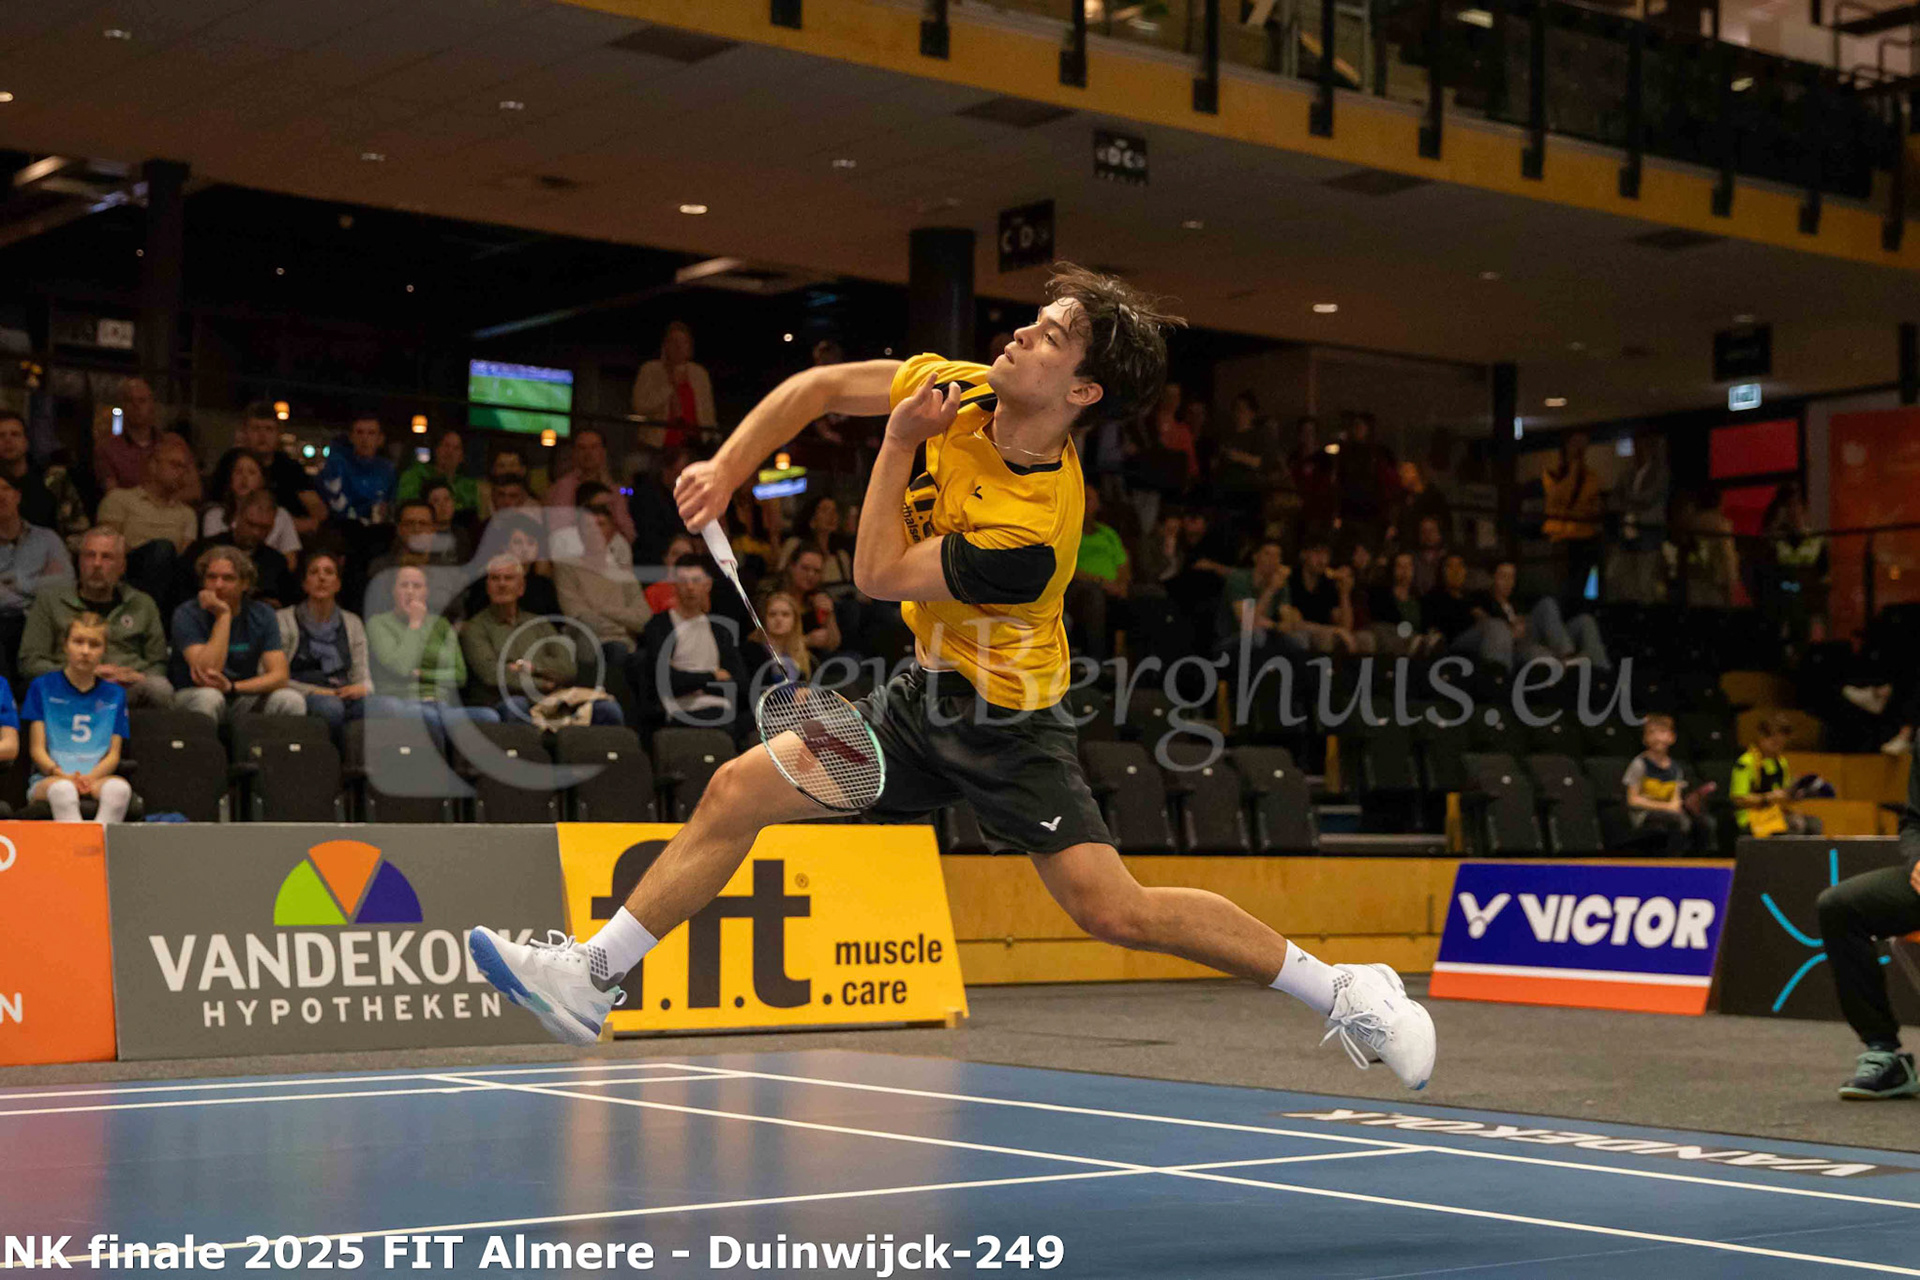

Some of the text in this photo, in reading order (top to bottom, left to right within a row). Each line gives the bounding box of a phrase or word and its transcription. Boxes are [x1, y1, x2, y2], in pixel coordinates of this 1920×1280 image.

[71, 714, 92, 743] 5
[1519, 893, 1715, 949] VICTOR
[835, 933, 942, 966] muscle
[203, 992, 501, 1028] HYPOTHEKEN
[1282, 1107, 1877, 1177] VANDEKOLK
